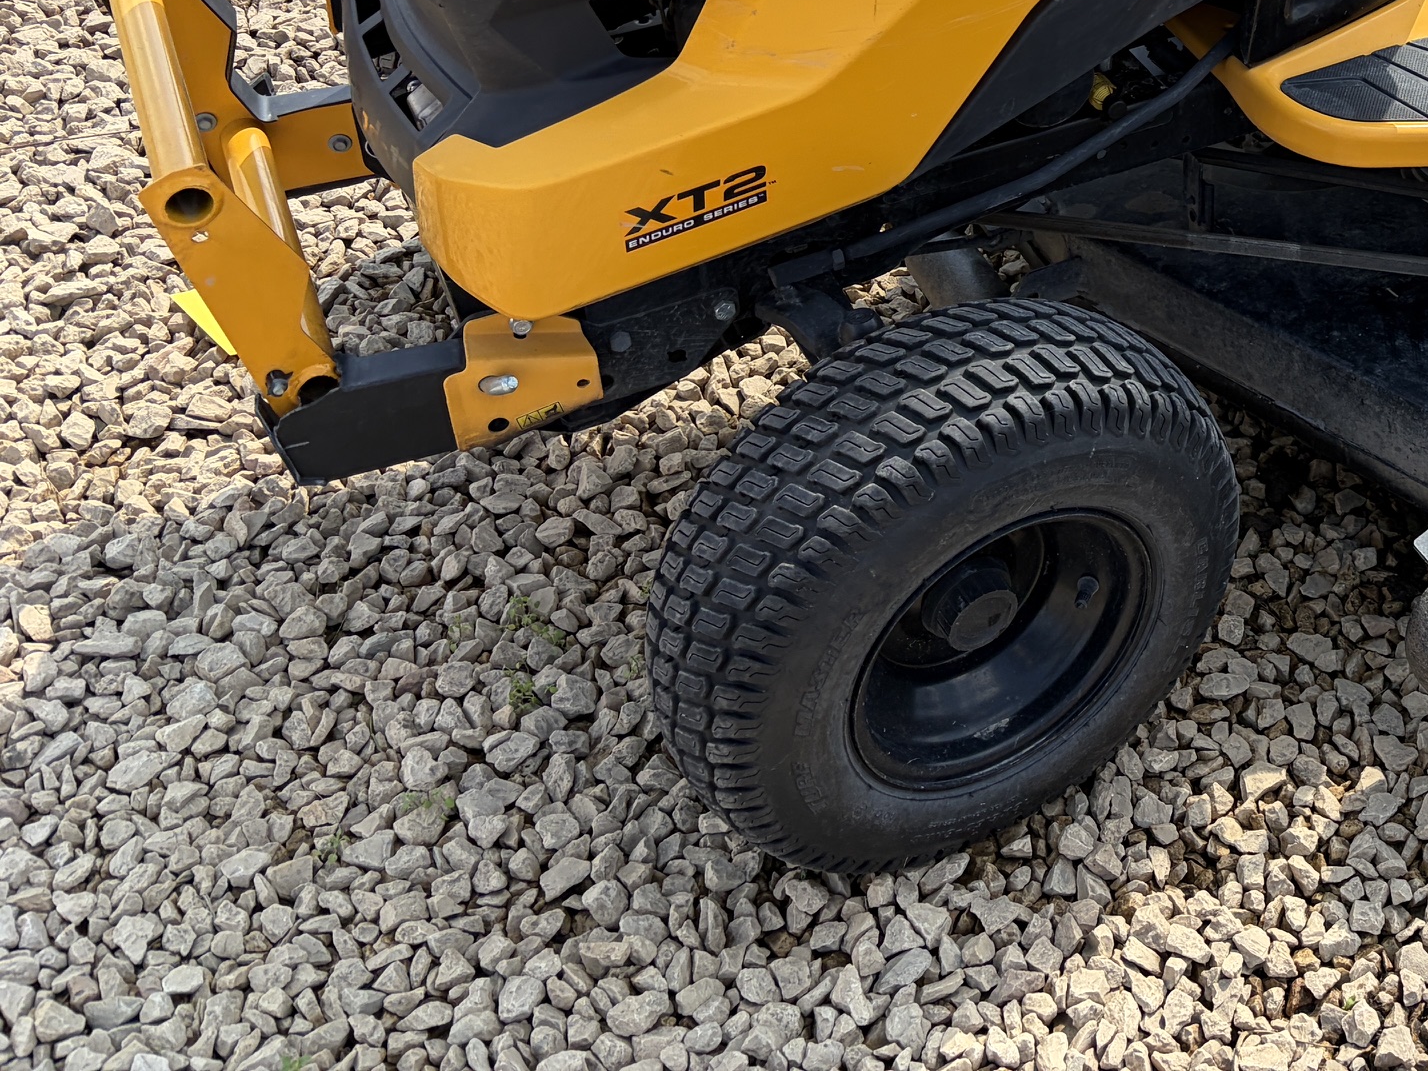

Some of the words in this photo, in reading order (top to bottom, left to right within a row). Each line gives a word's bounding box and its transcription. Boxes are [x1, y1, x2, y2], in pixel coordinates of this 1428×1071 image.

[624, 165, 767, 237] XT2
[628, 219, 695, 248] ENDURO
[703, 195, 759, 221] SERIES
